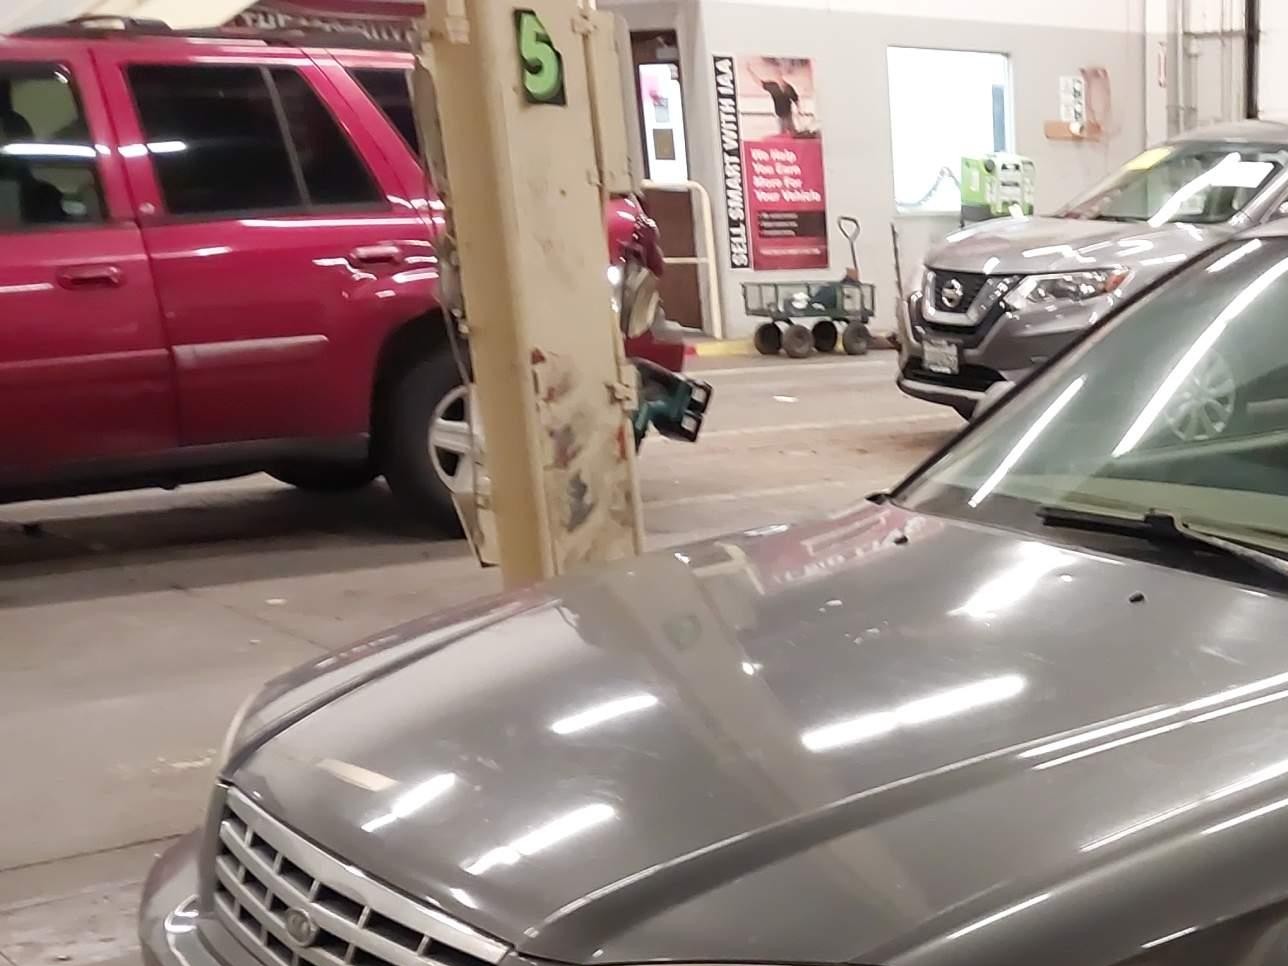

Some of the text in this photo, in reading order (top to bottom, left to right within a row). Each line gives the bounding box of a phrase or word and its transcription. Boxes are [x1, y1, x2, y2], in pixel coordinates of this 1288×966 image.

[520, 12, 560, 97] 5
[715, 58, 748, 266] SELL SMART WITH IAA
[769, 147, 797, 164] Help
[752, 162, 802, 175] You Earn
[753, 175, 803, 188] More For
[754, 188, 822, 202] Your Vehicle
